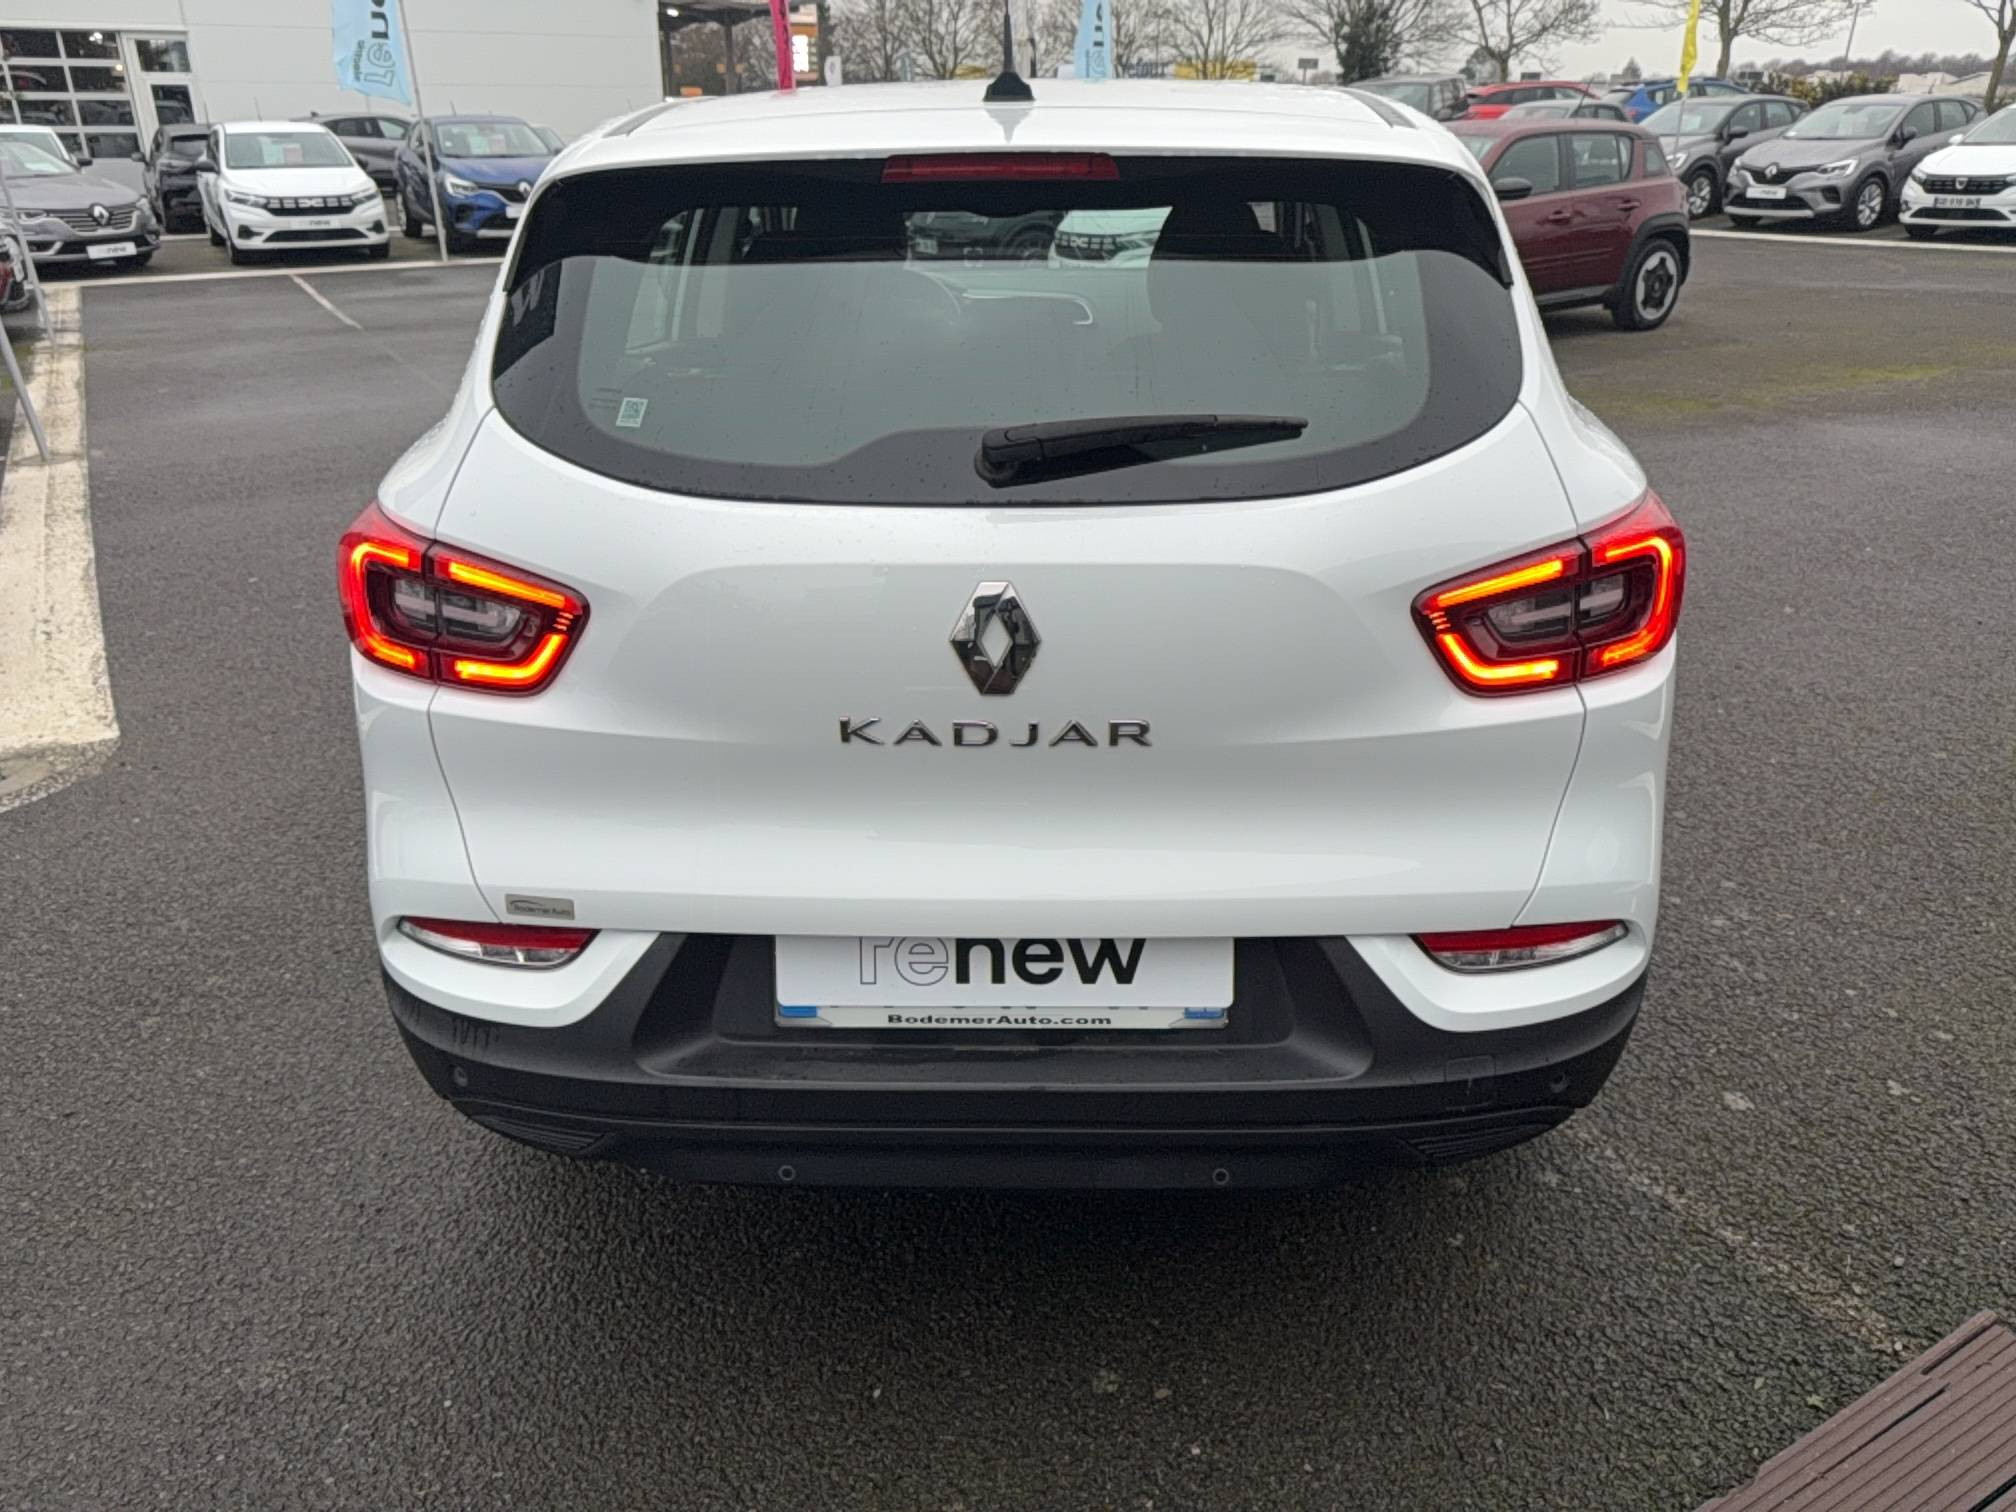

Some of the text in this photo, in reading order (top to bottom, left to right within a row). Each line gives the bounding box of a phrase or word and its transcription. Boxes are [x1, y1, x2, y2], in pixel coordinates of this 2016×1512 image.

[839, 717, 1152, 747] KADJAR
[859, 937, 1147, 987] renew
[887, 1013, 1112, 1026] BodemerAuto.com
